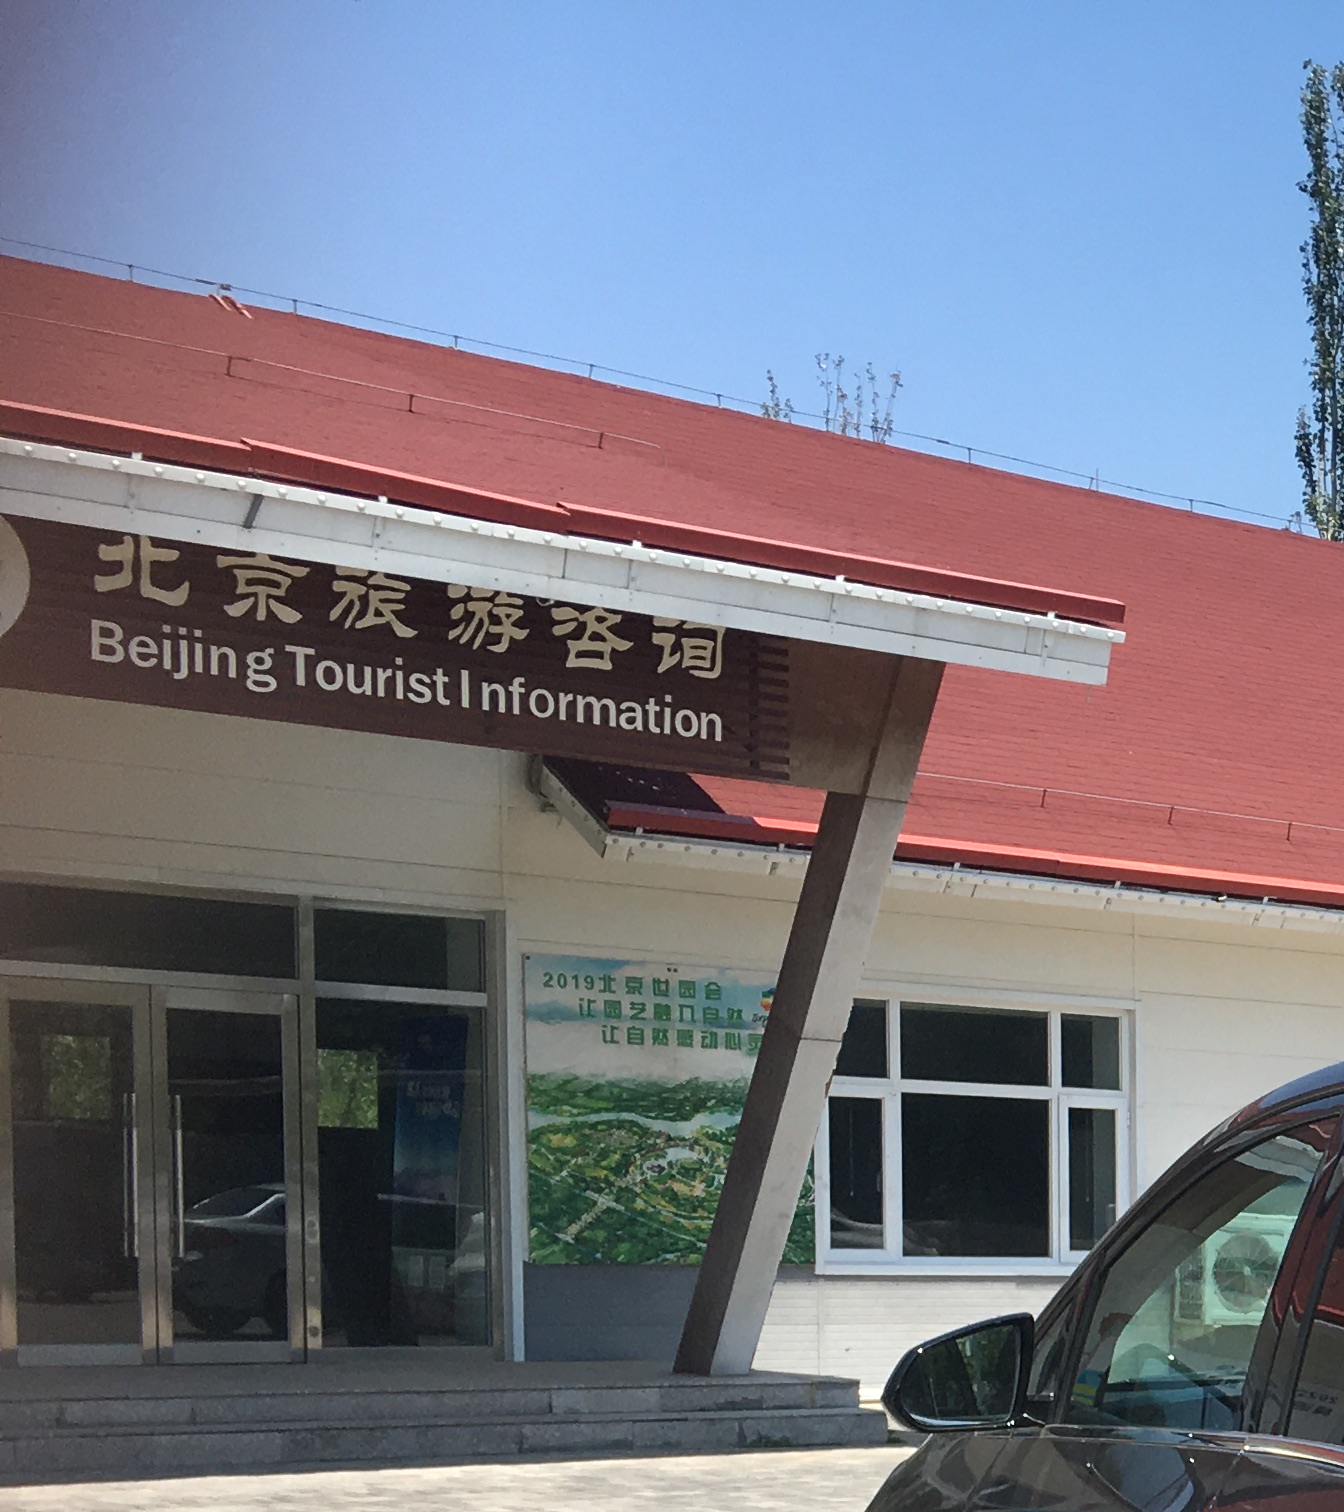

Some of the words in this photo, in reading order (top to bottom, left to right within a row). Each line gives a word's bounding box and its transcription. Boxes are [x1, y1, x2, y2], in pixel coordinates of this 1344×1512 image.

[94, 535, 726, 679] 北京旅游咨询
[90, 618, 278, 693] Beijing
[285, 644, 450, 706] Tourist
[460, 669, 723, 742] Information
[542, 971, 722, 1000] 2019北京世园会
[577, 997, 744, 1027] 让园艺融入自然
